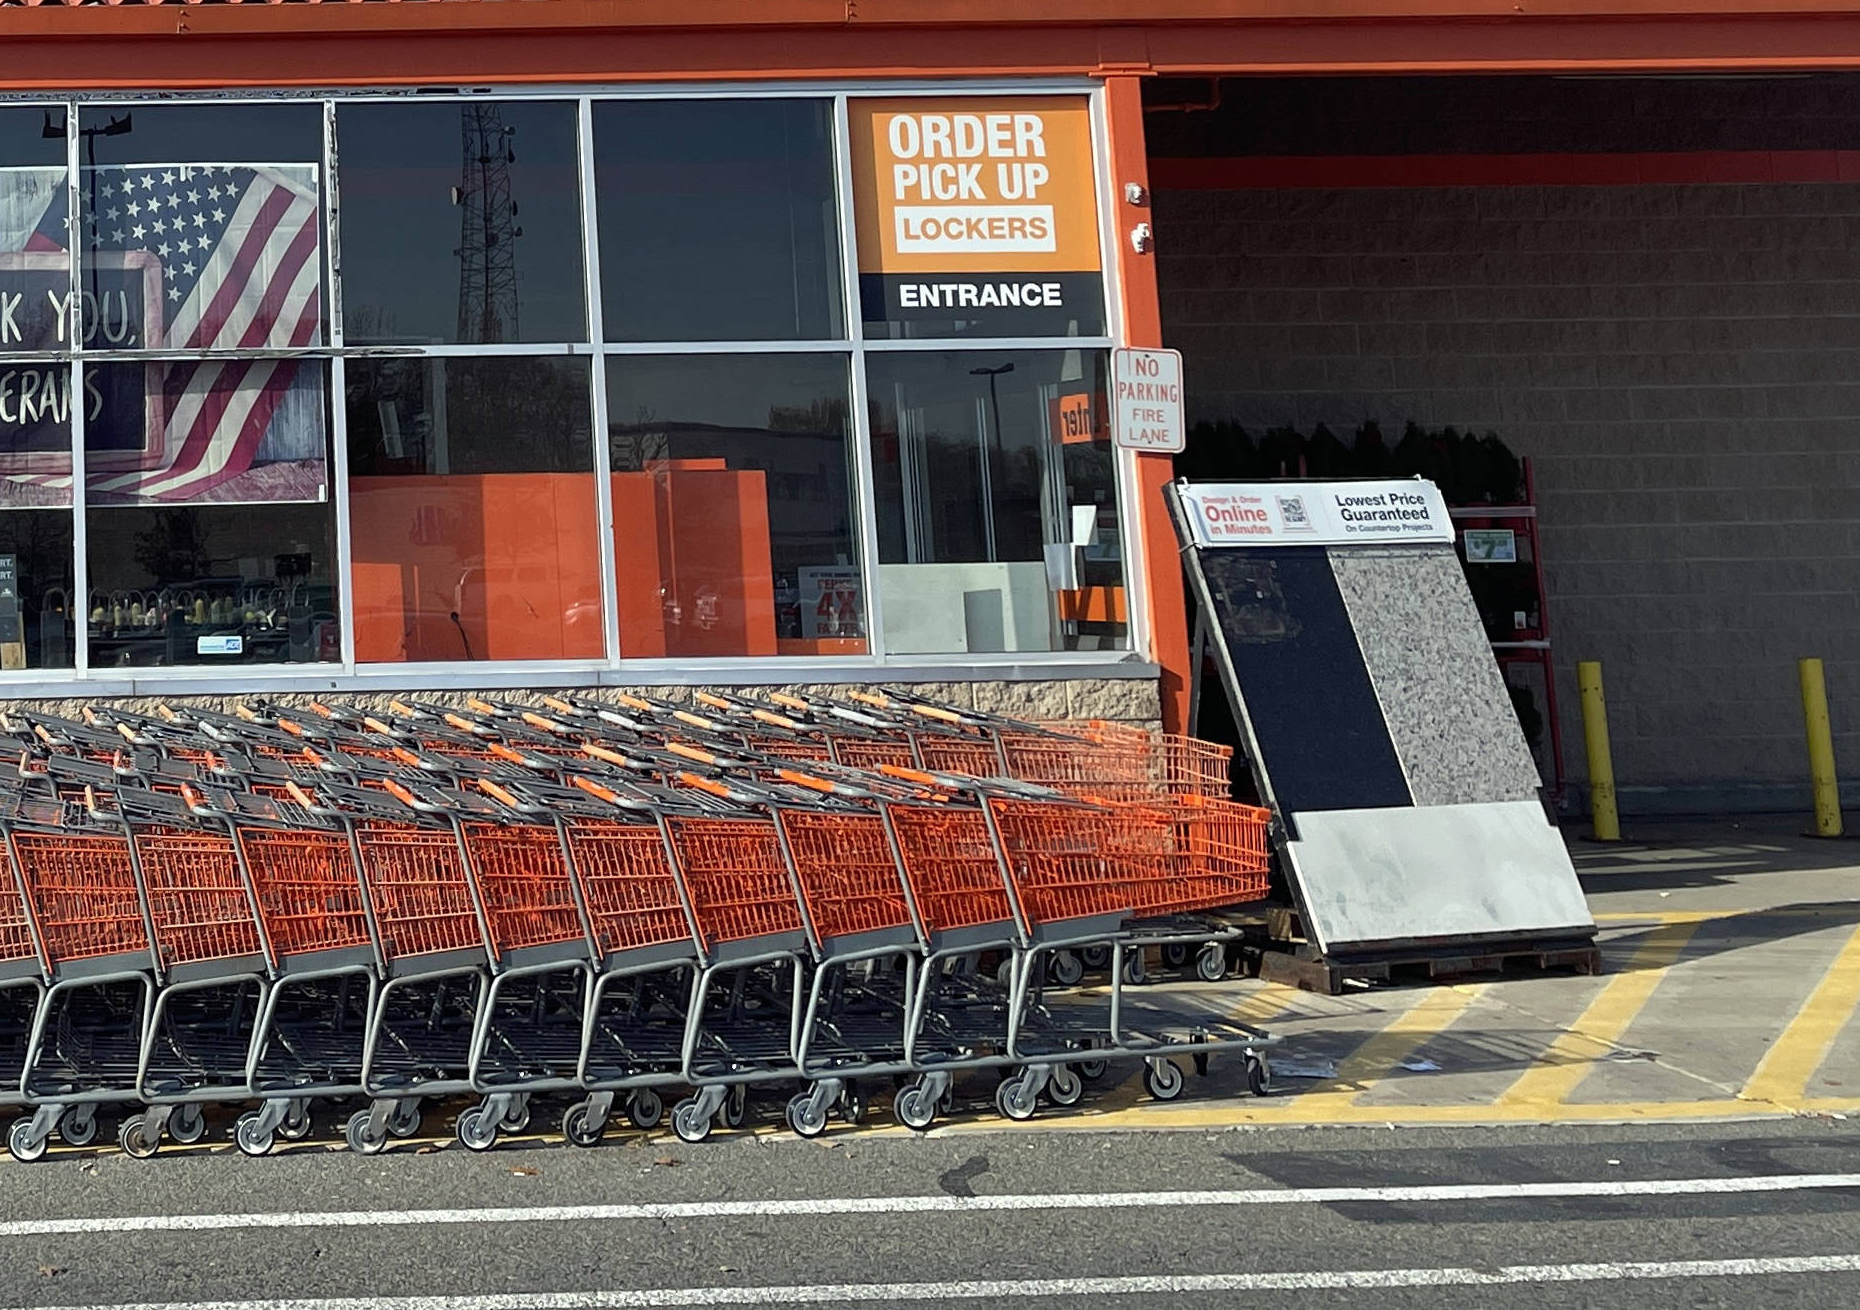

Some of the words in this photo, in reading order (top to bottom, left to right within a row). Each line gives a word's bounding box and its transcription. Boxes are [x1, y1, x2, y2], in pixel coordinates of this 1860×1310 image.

[889, 114, 1047, 159] ORDER
[893, 163, 987, 201] PICK
[997, 162, 1049, 200] UP
[903, 217, 1048, 241] LOCKERS
[899, 282, 1063, 308] ENTRANCE
[1135, 357, 1159, 377] NO
[1119, 381, 1178, 403] PARKING
[1132, 408, 1165, 423] FIRE
[1129, 426, 1170, 443] LANE
[1335, 493, 1388, 507] Lowest
[1389, 492, 1425, 506] Price
[1205, 504, 1268, 522] Online
[1341, 506, 1430, 522] Guaranteed
[1225, 524, 1273, 534] Minutes
[1346, 524, 1357, 532] On
[1358, 524, 1401, 533] Countertop
[1402, 523, 1434, 533] Projects
